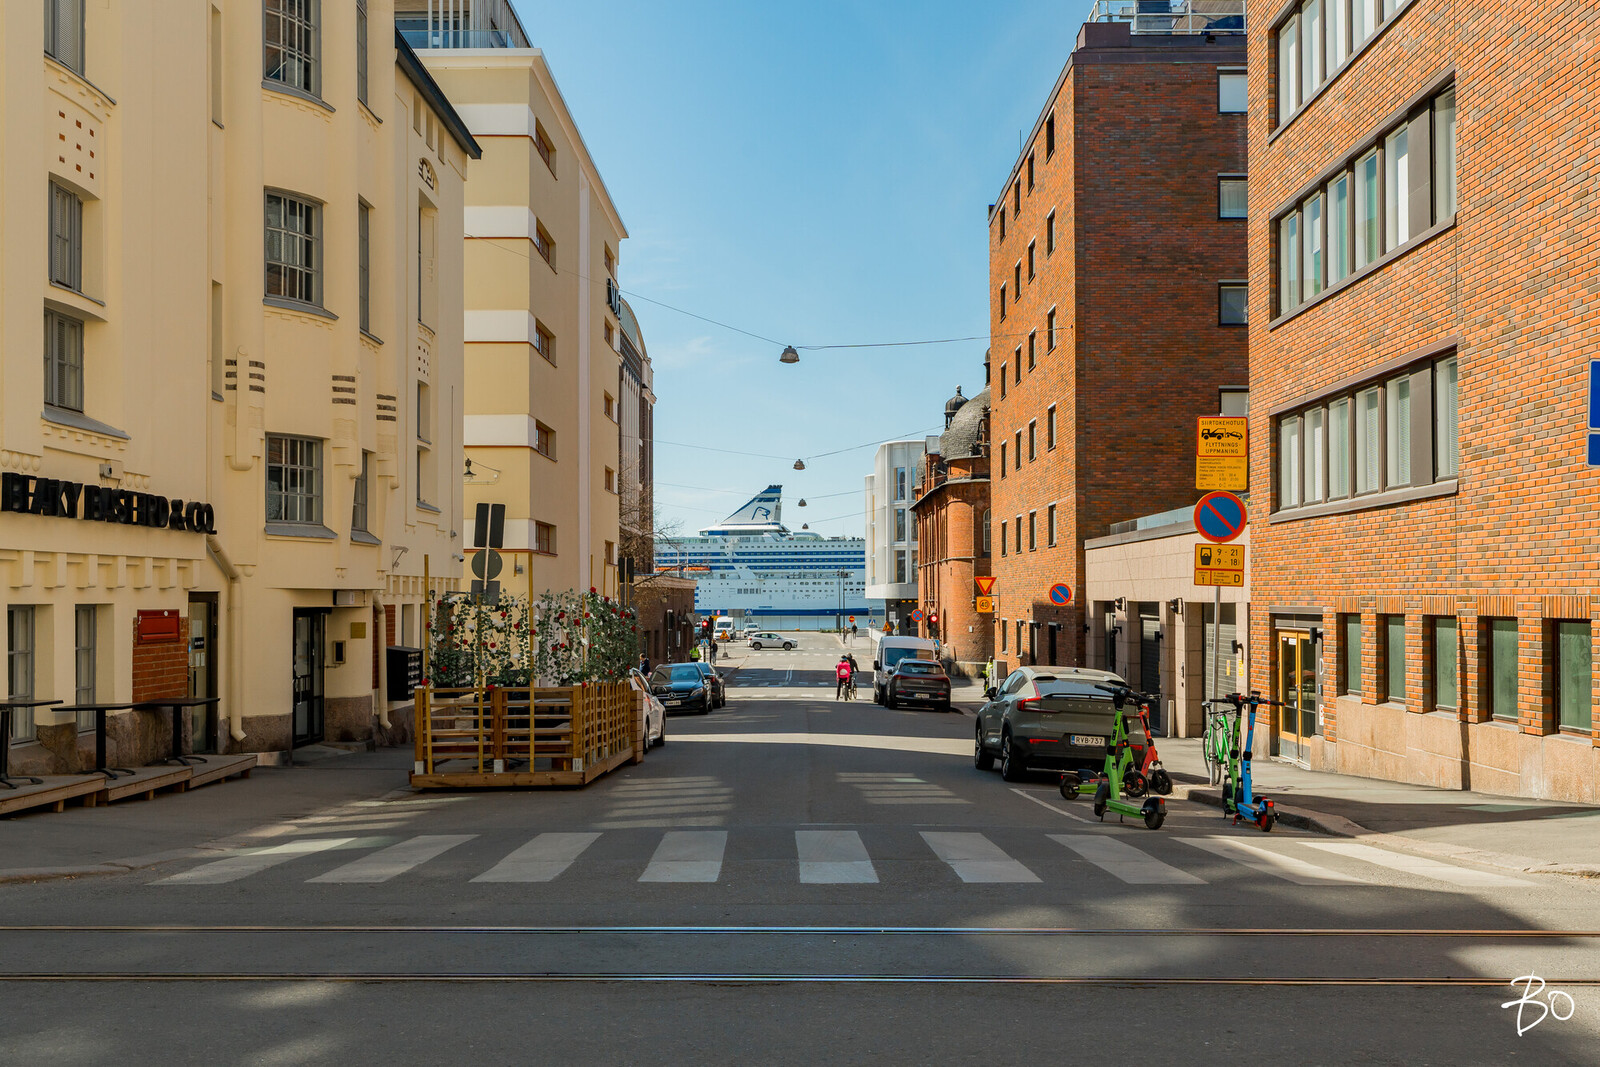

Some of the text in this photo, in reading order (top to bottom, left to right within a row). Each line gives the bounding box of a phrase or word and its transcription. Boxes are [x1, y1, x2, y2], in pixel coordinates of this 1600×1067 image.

[1217, 548, 1222, 556] 9
[1231, 548, 1238, 556] 21
[1234, 574, 1241, 583] D
[1075, 736, 1103, 745] RVB-737
